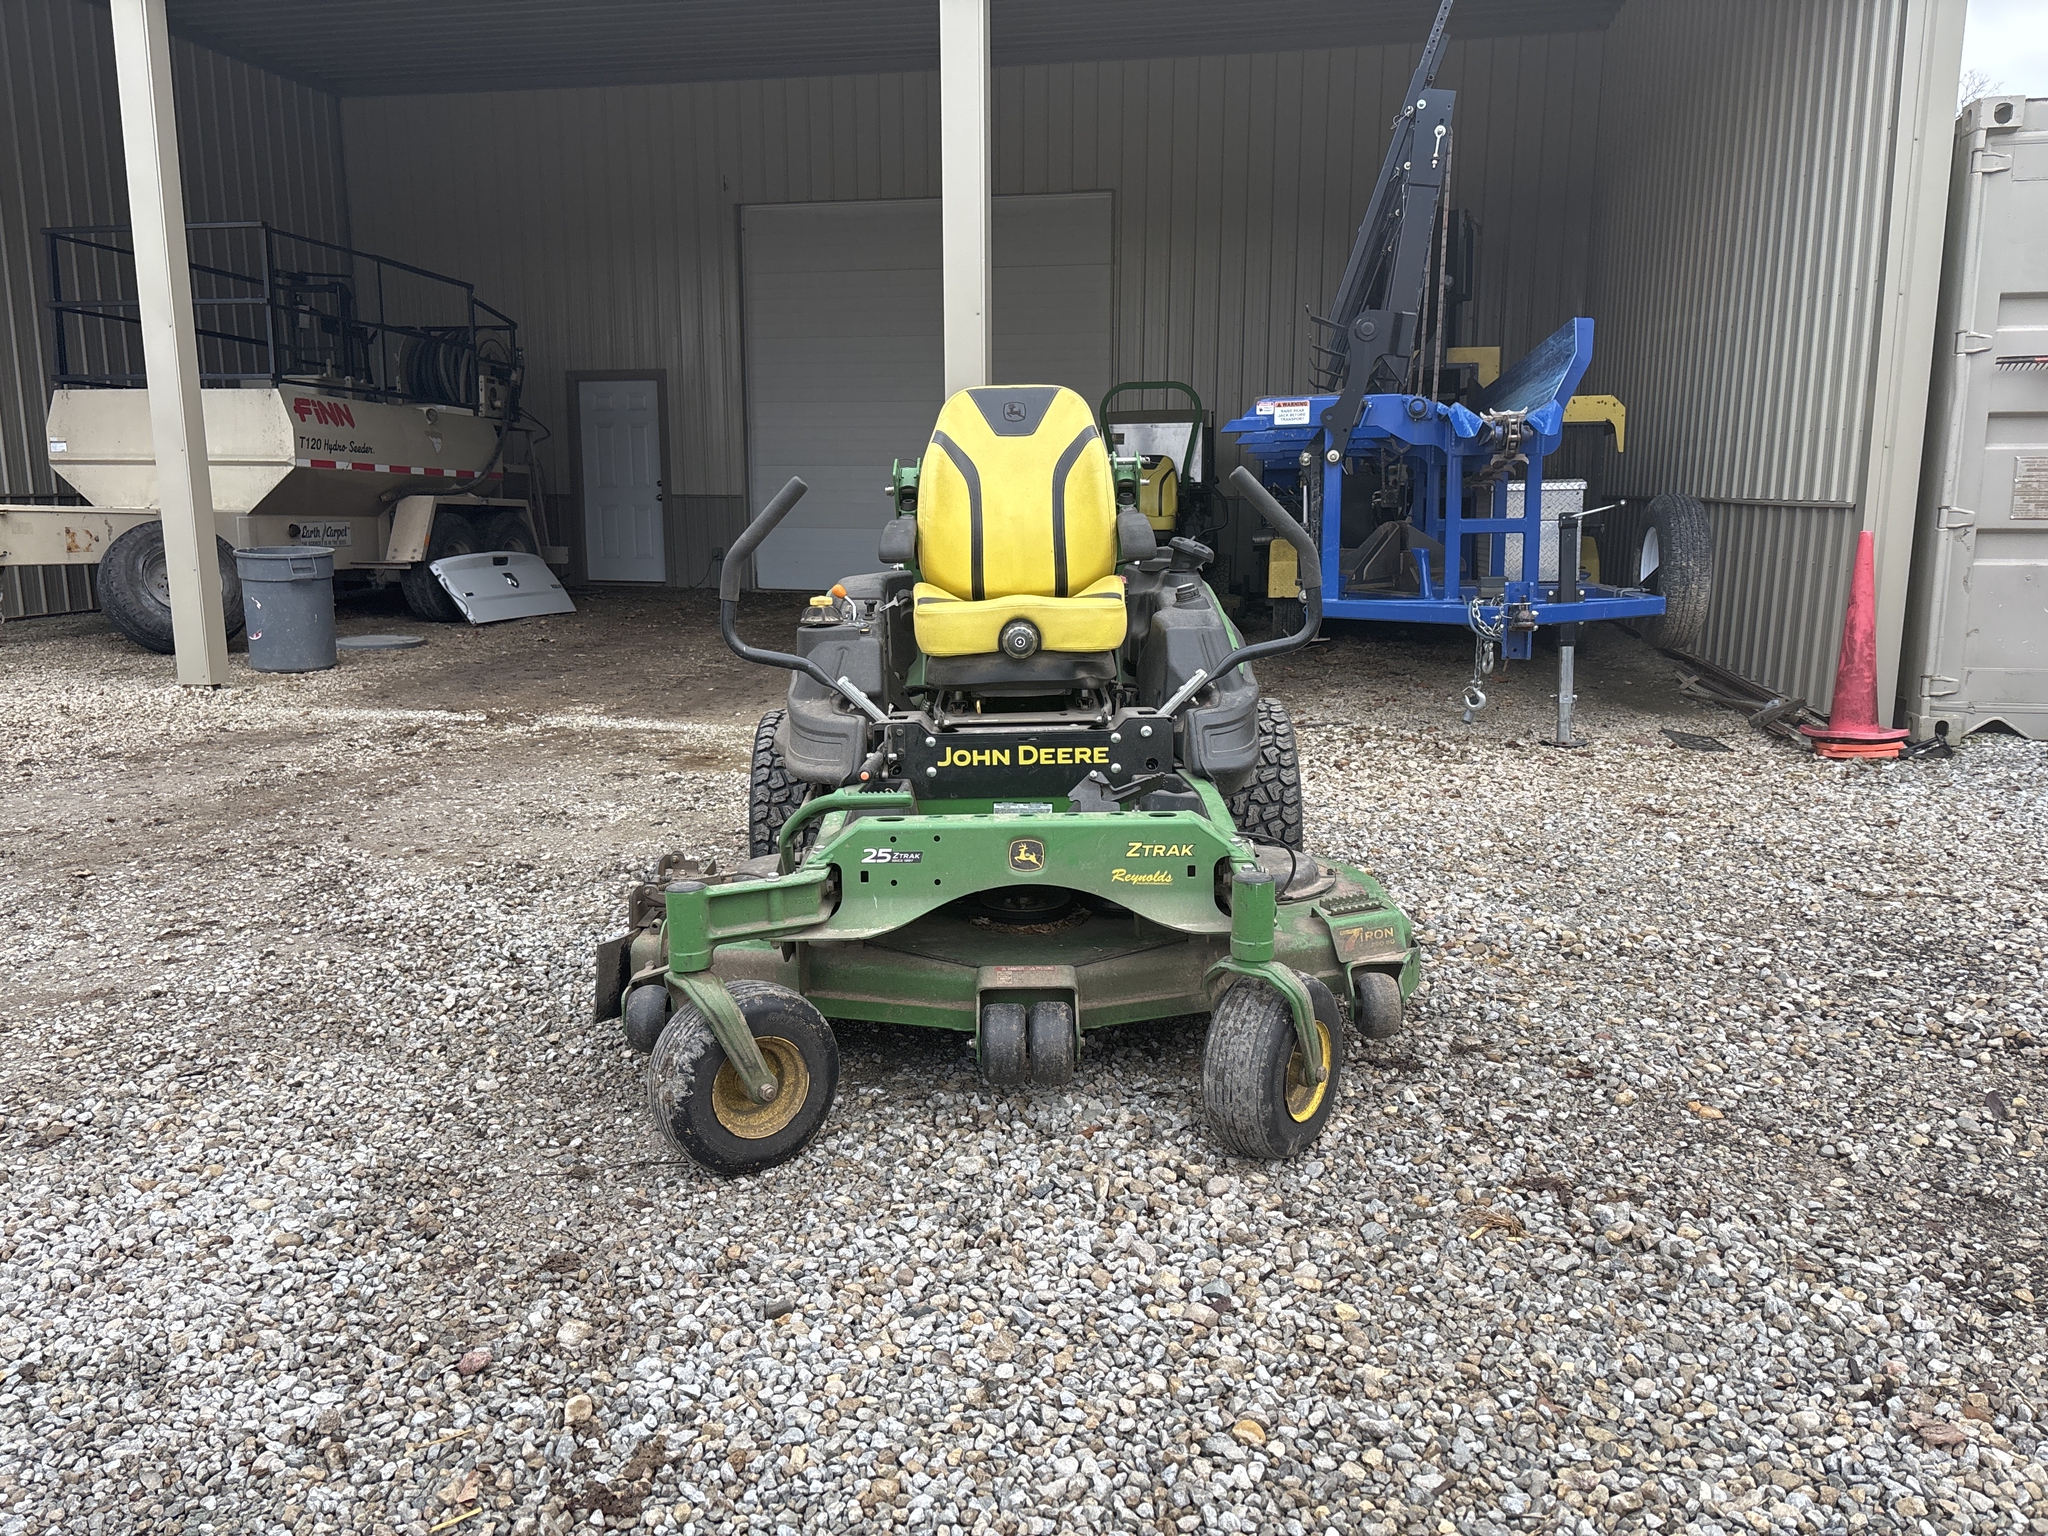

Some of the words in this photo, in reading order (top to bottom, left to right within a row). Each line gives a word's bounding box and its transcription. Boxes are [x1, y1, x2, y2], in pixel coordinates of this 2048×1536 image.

[300, 436, 322, 451] T120
[323, 438, 347, 454] Hydro
[301, 524, 321, 538] Earth
[937, 746, 1011, 767] JOHN
[1018, 745, 1110, 765] DEERE
[861, 848, 893, 863] 25
[1125, 842, 1195, 857] ZTRAK
[1111, 868, 1173, 885] Reynolds
